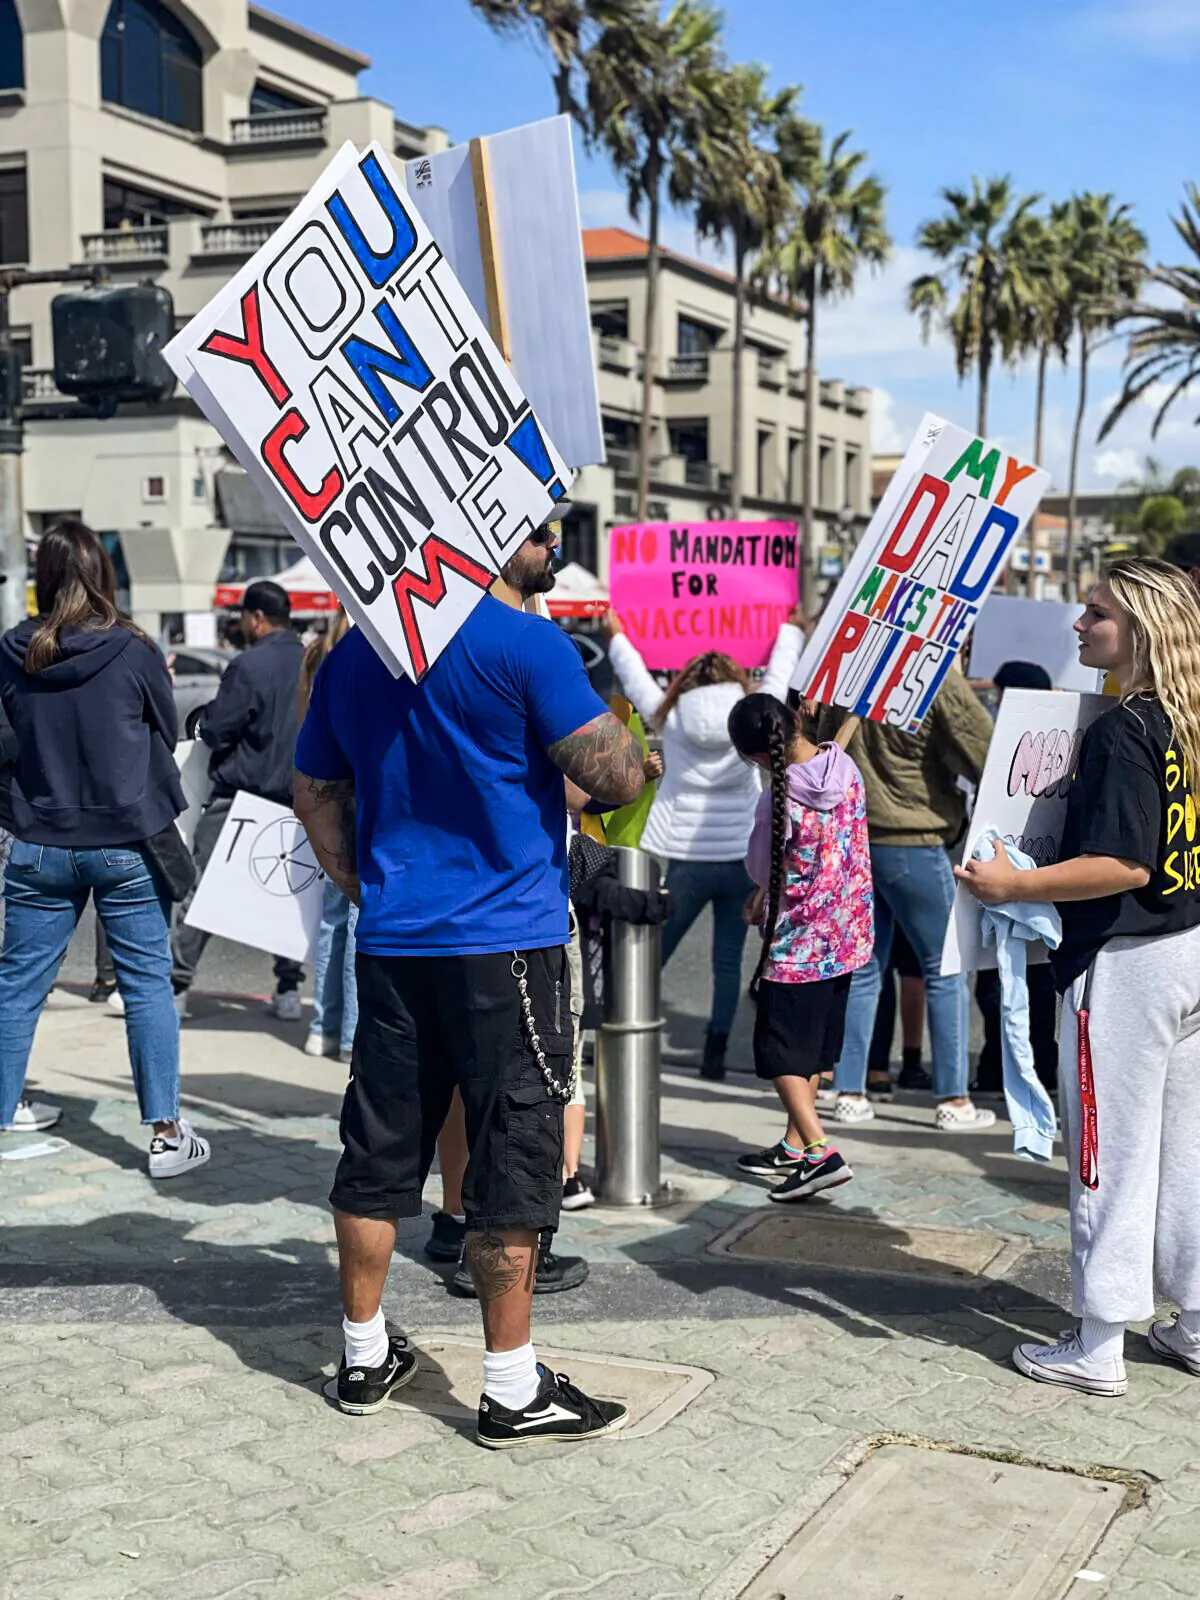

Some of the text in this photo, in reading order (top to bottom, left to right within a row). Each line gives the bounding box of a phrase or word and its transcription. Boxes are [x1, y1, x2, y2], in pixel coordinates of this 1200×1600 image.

[198, 149, 419, 409] YOU
[261, 240, 443, 525] CAN'T
[319, 338, 533, 605] CONTROL
[943, 438, 1037, 507] MY
[392, 410, 566, 683] ME!
[615, 529, 658, 565] NO
[671, 571, 719, 598] FOR
[876, 472, 1020, 603] DAD
[804, 609, 957, 732] RULES!
[849, 565, 979, 650] MAKES THE
